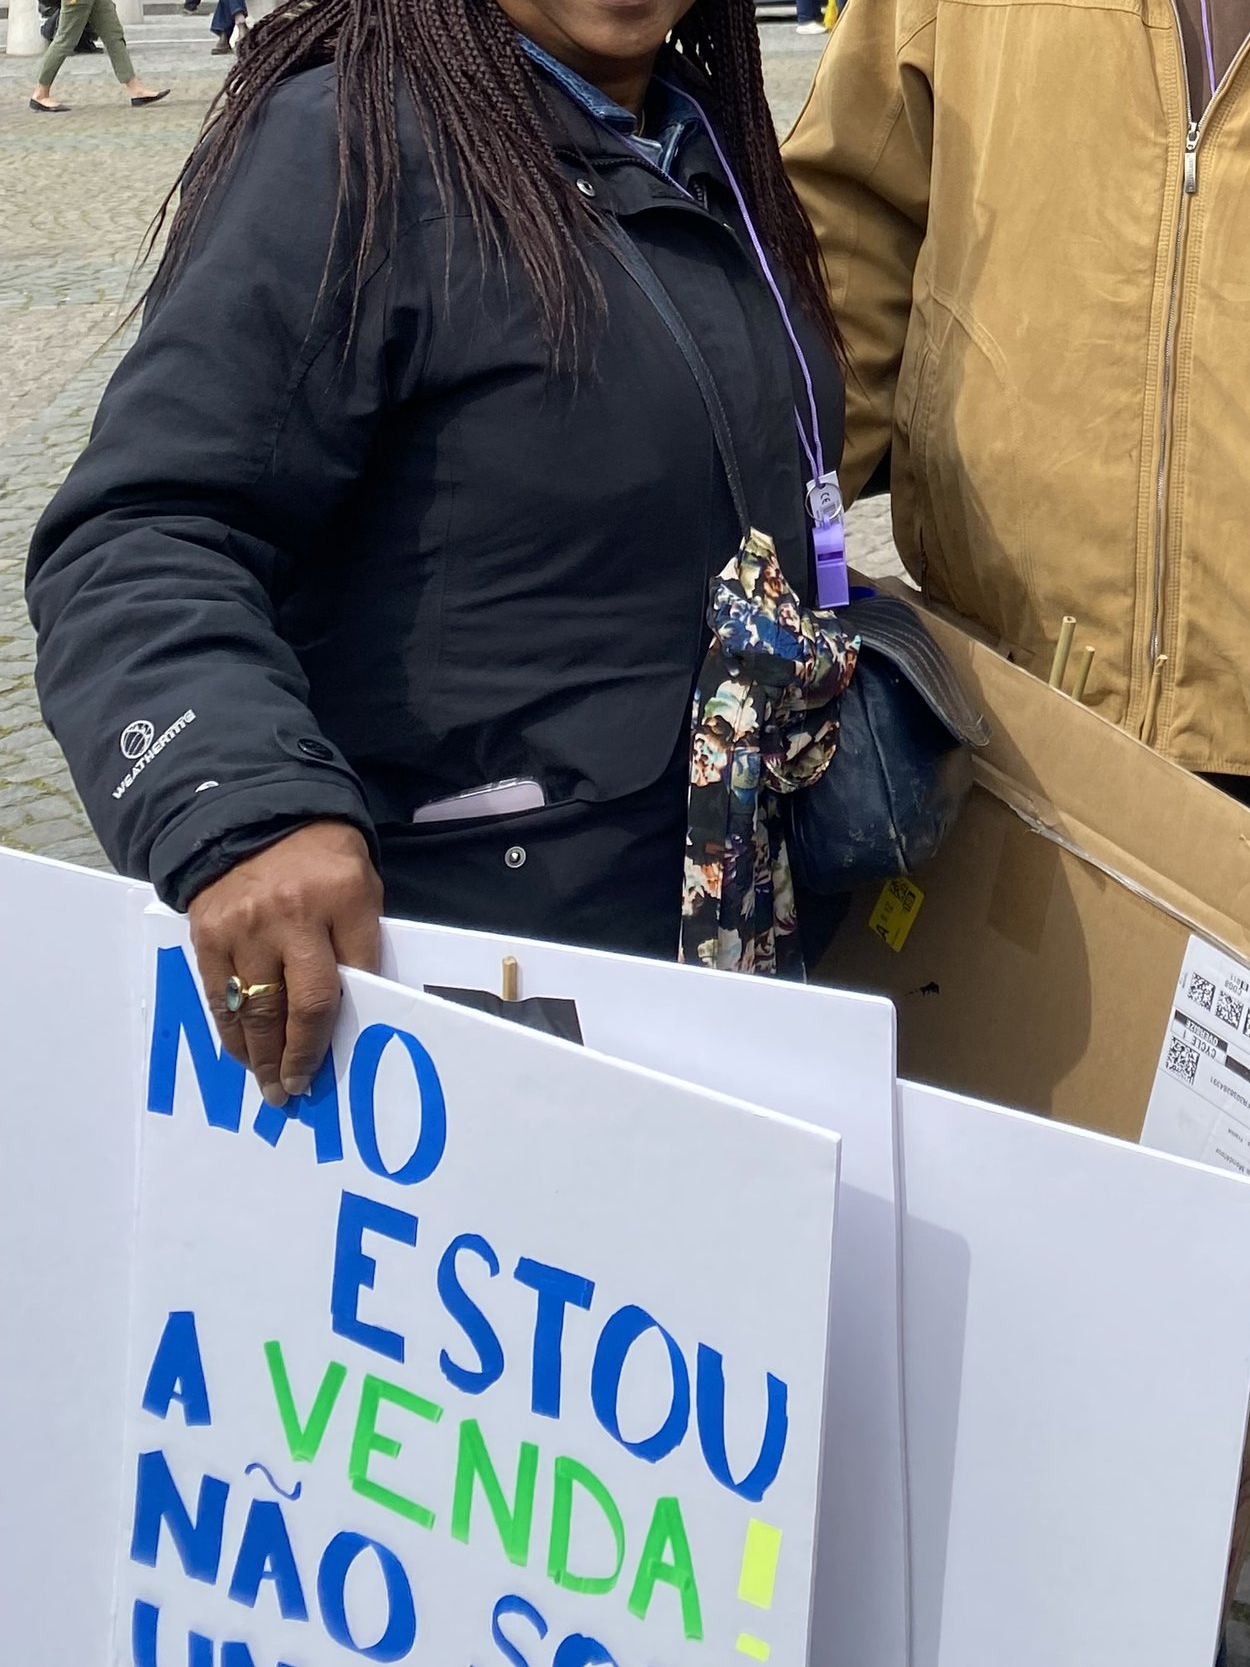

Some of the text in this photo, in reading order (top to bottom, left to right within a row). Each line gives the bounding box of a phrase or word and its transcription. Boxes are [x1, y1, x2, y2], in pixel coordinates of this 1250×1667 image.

[1189, 1035, 1217, 1059] CYCLE
[332, 1190, 788, 1502] ESTOU
[130, 1450, 416, 1663] NÃO
[142, 1311, 783, 1660] A VENDA!
